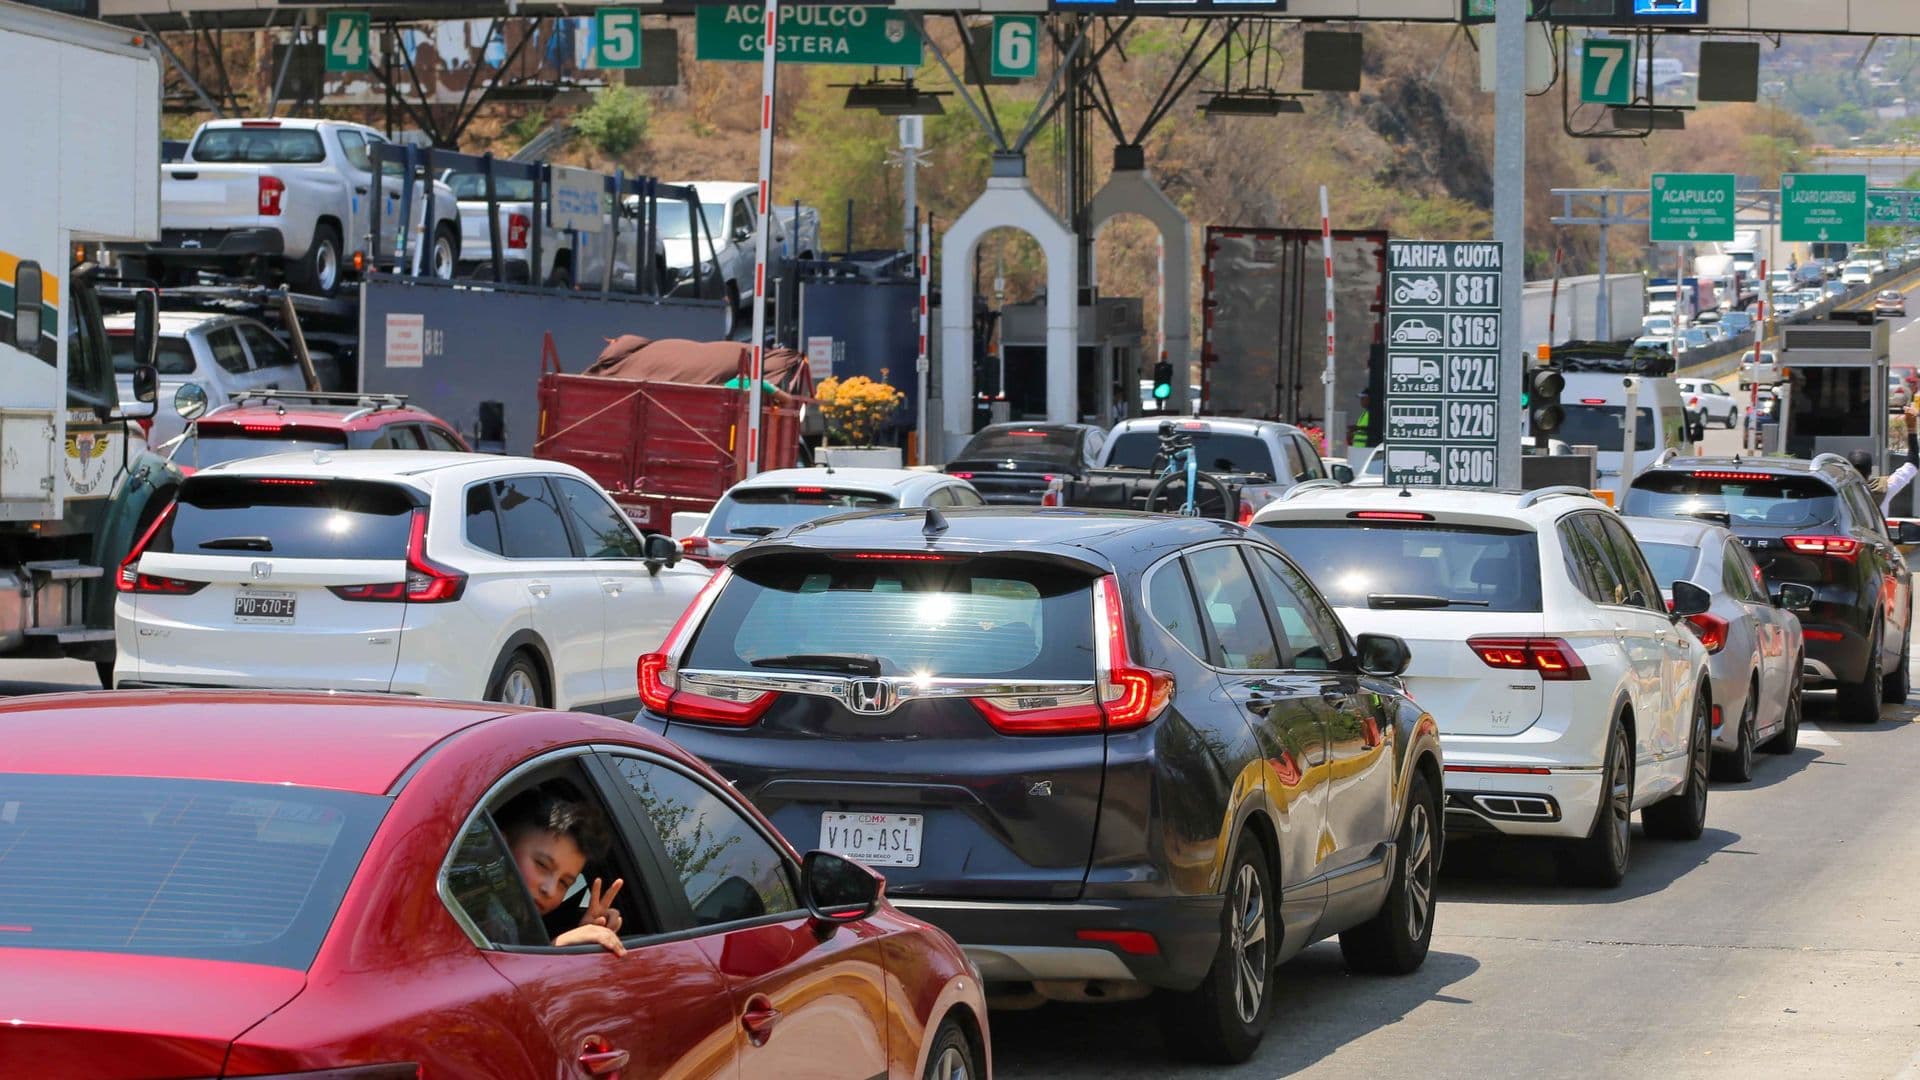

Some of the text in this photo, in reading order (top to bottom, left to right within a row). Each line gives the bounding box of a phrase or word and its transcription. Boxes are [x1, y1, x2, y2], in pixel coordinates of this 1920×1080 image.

[724, 5, 867, 26] ACPULCO
[332, 19, 363, 64] 4
[603, 15, 634, 61] 5
[999, 22, 1032, 69] 6
[1589, 47, 1624, 96] 7
[1662, 189, 1725, 203] ACAPULCO
[1390, 245, 1500, 268] TARIFA CUOTA
[1455, 274, 1494, 306] $81
[1451, 315, 1497, 347] $163
[1420, 383, 1440, 392] EJES
[1450, 356, 1495, 393] $224
[1418, 428, 1438, 437] EJES
[1449, 402, 1494, 438] $226
[1413, 475, 1434, 484] EJES
[1448, 448, 1493, 484] $306
[235, 598, 294, 615] PVD-670-E
[858, 815, 886, 823] CDMX
[828, 826, 913, 851] V10-ASL
